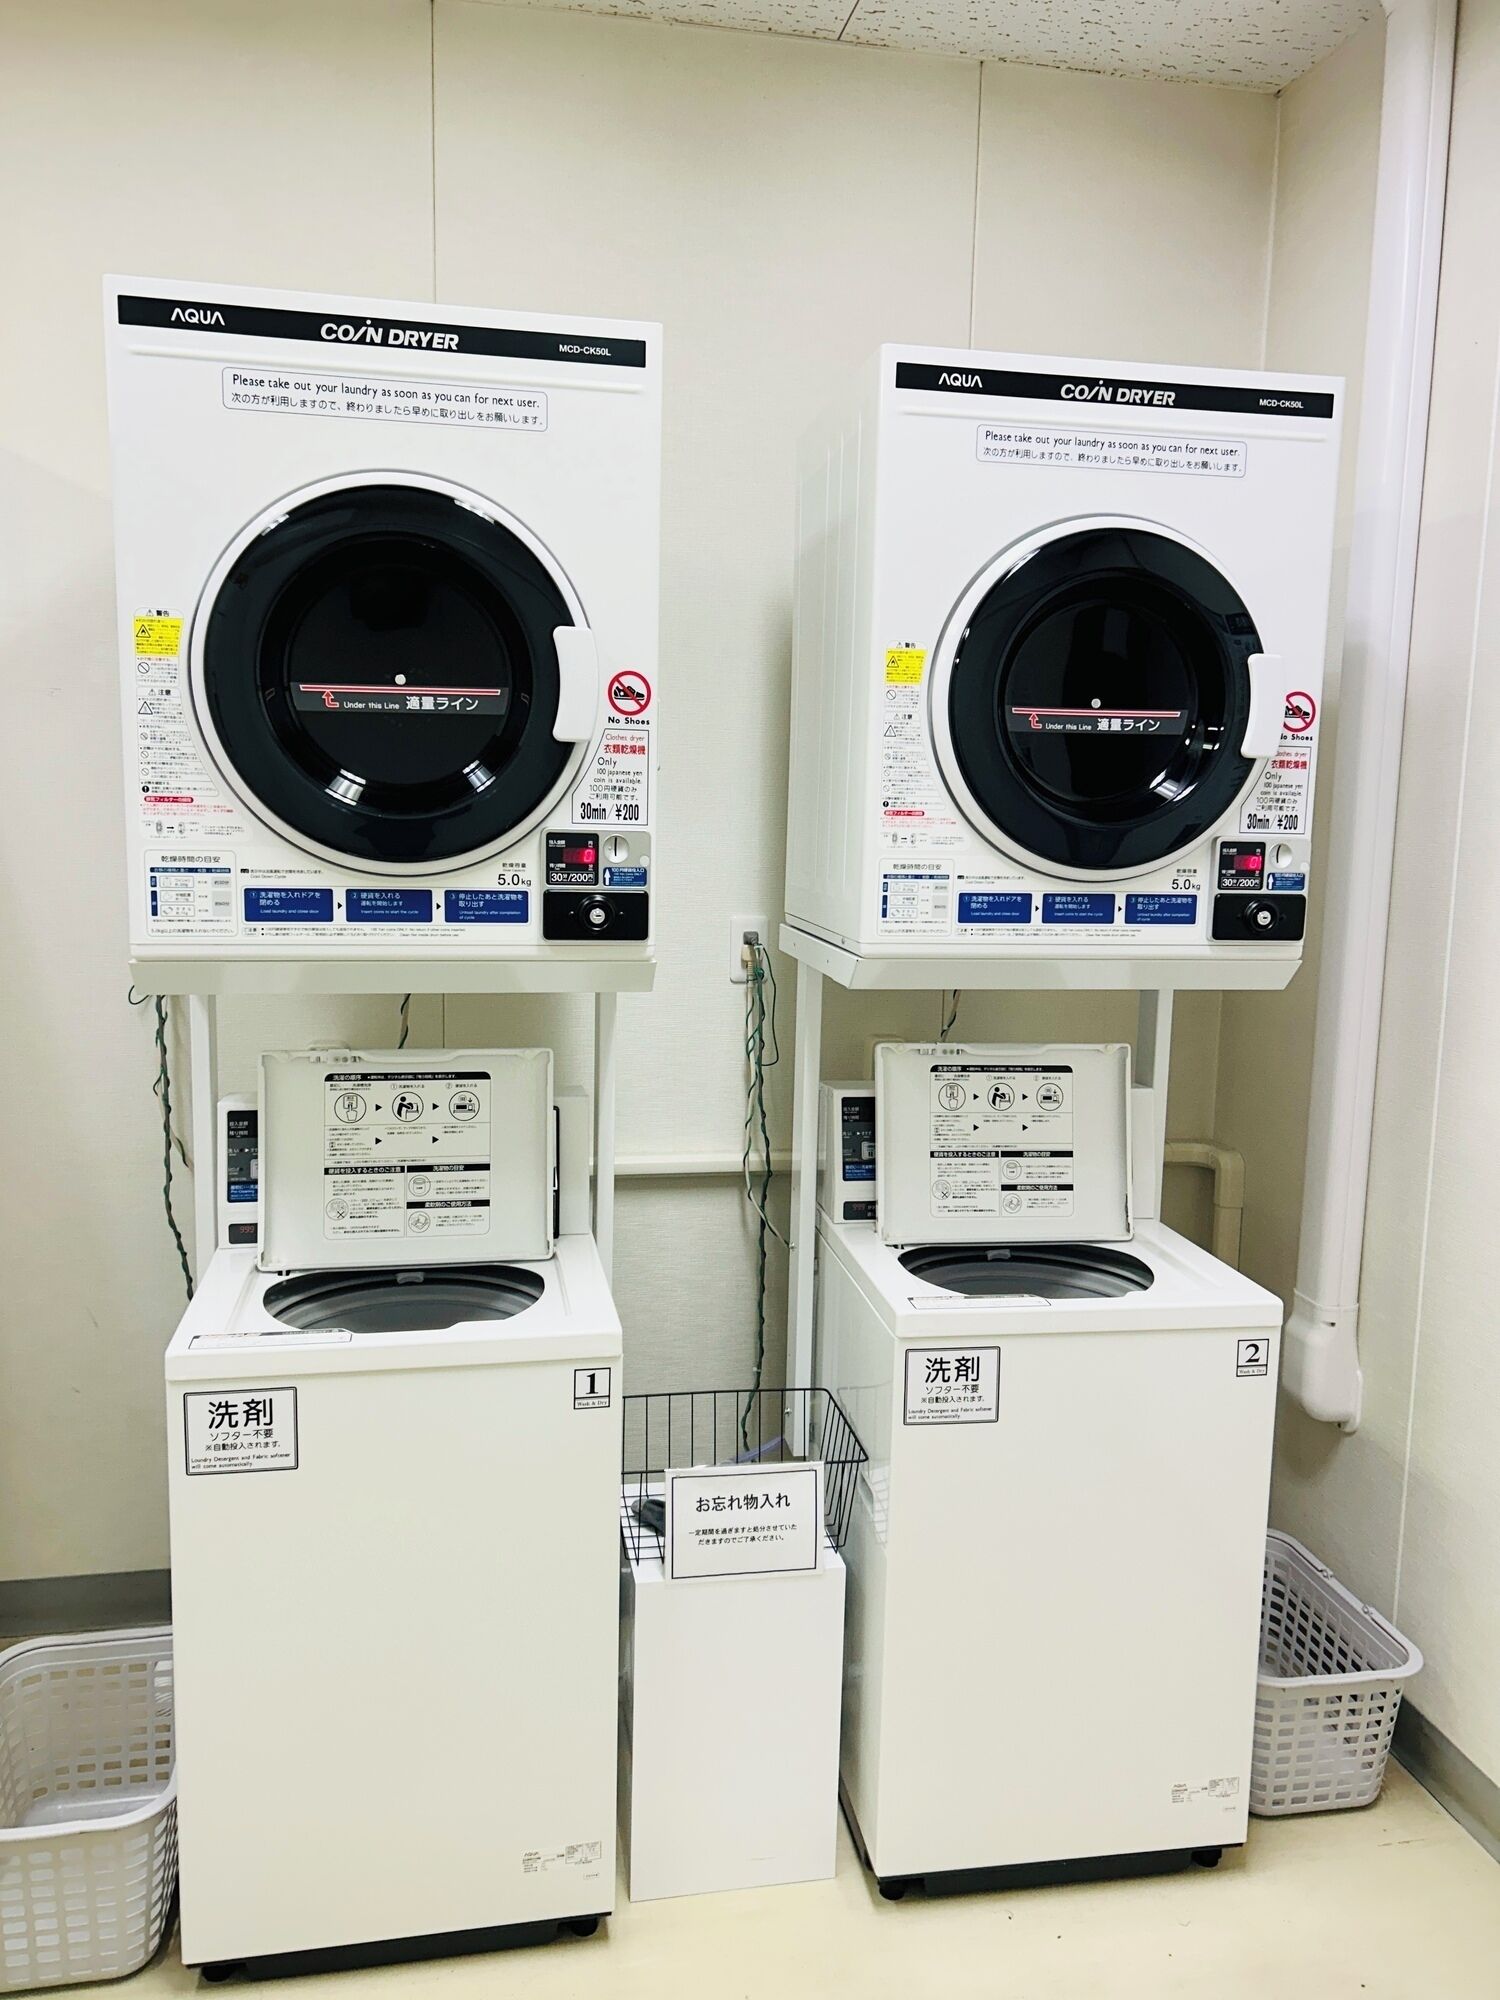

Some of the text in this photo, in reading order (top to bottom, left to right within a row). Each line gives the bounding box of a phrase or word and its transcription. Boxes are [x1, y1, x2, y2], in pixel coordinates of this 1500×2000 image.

[171, 308, 225, 326] AQUA
[389, 330, 459, 350] DRYER
[559, 344, 611, 356] MCD-CK50L
[939, 373, 982, 387] AQUA
[233, 374, 265, 387] Please
[269, 378, 289, 389] take
[294, 383, 311, 391] out
[316, 384, 337, 394] your
[342, 383, 377, 399] laundry
[395, 390, 417, 399] soon
[422, 392, 431, 400] as
[435, 394, 451, 403] you
[455, 394, 470, 402] can
[475, 393, 489, 404] for
[493, 398, 513, 406] next
[517, 400, 539, 408] user.
[1116, 389, 1175, 405] DRYER
[1259, 399, 1304, 408] MCD-CK50L
[986, 431, 1011, 441] Please
[1015, 434, 1031, 442] take
[1054, 438, 1071, 447] your
[1075, 437, 1104, 450] laundry
[1152, 445, 1166, 453] you
[1186, 444, 1197, 453] for
[384, 702, 399, 710] Line
[406, 696, 478, 711] 適量ライン
[625, 717, 649, 725] Shoes
[1097, 718, 1160, 731] 適量ライン
[606, 733, 645, 743] Clothes dryer
[604, 744, 645, 755] 衣類乾燥機
[598, 757, 617, 768] Only
[1265, 772, 1282, 782] Only
[1245, 1344, 1260, 1363] 2
[925, 1356, 980, 1383] 洗剤
[586, 1373, 598, 1394] 1
[926, 1384, 980, 1394] ソフター不要
[208, 1398, 273, 1429] 洗剤
[210, 1428, 274, 1441] ソフター不要
[696, 1493, 790, 1512] お忘れ物入れ
[688, 1524, 797, 1536] 一定期間を過ぎますと処分させていた
[698, 1535, 784, 1546] だきますのでご了承ください。
